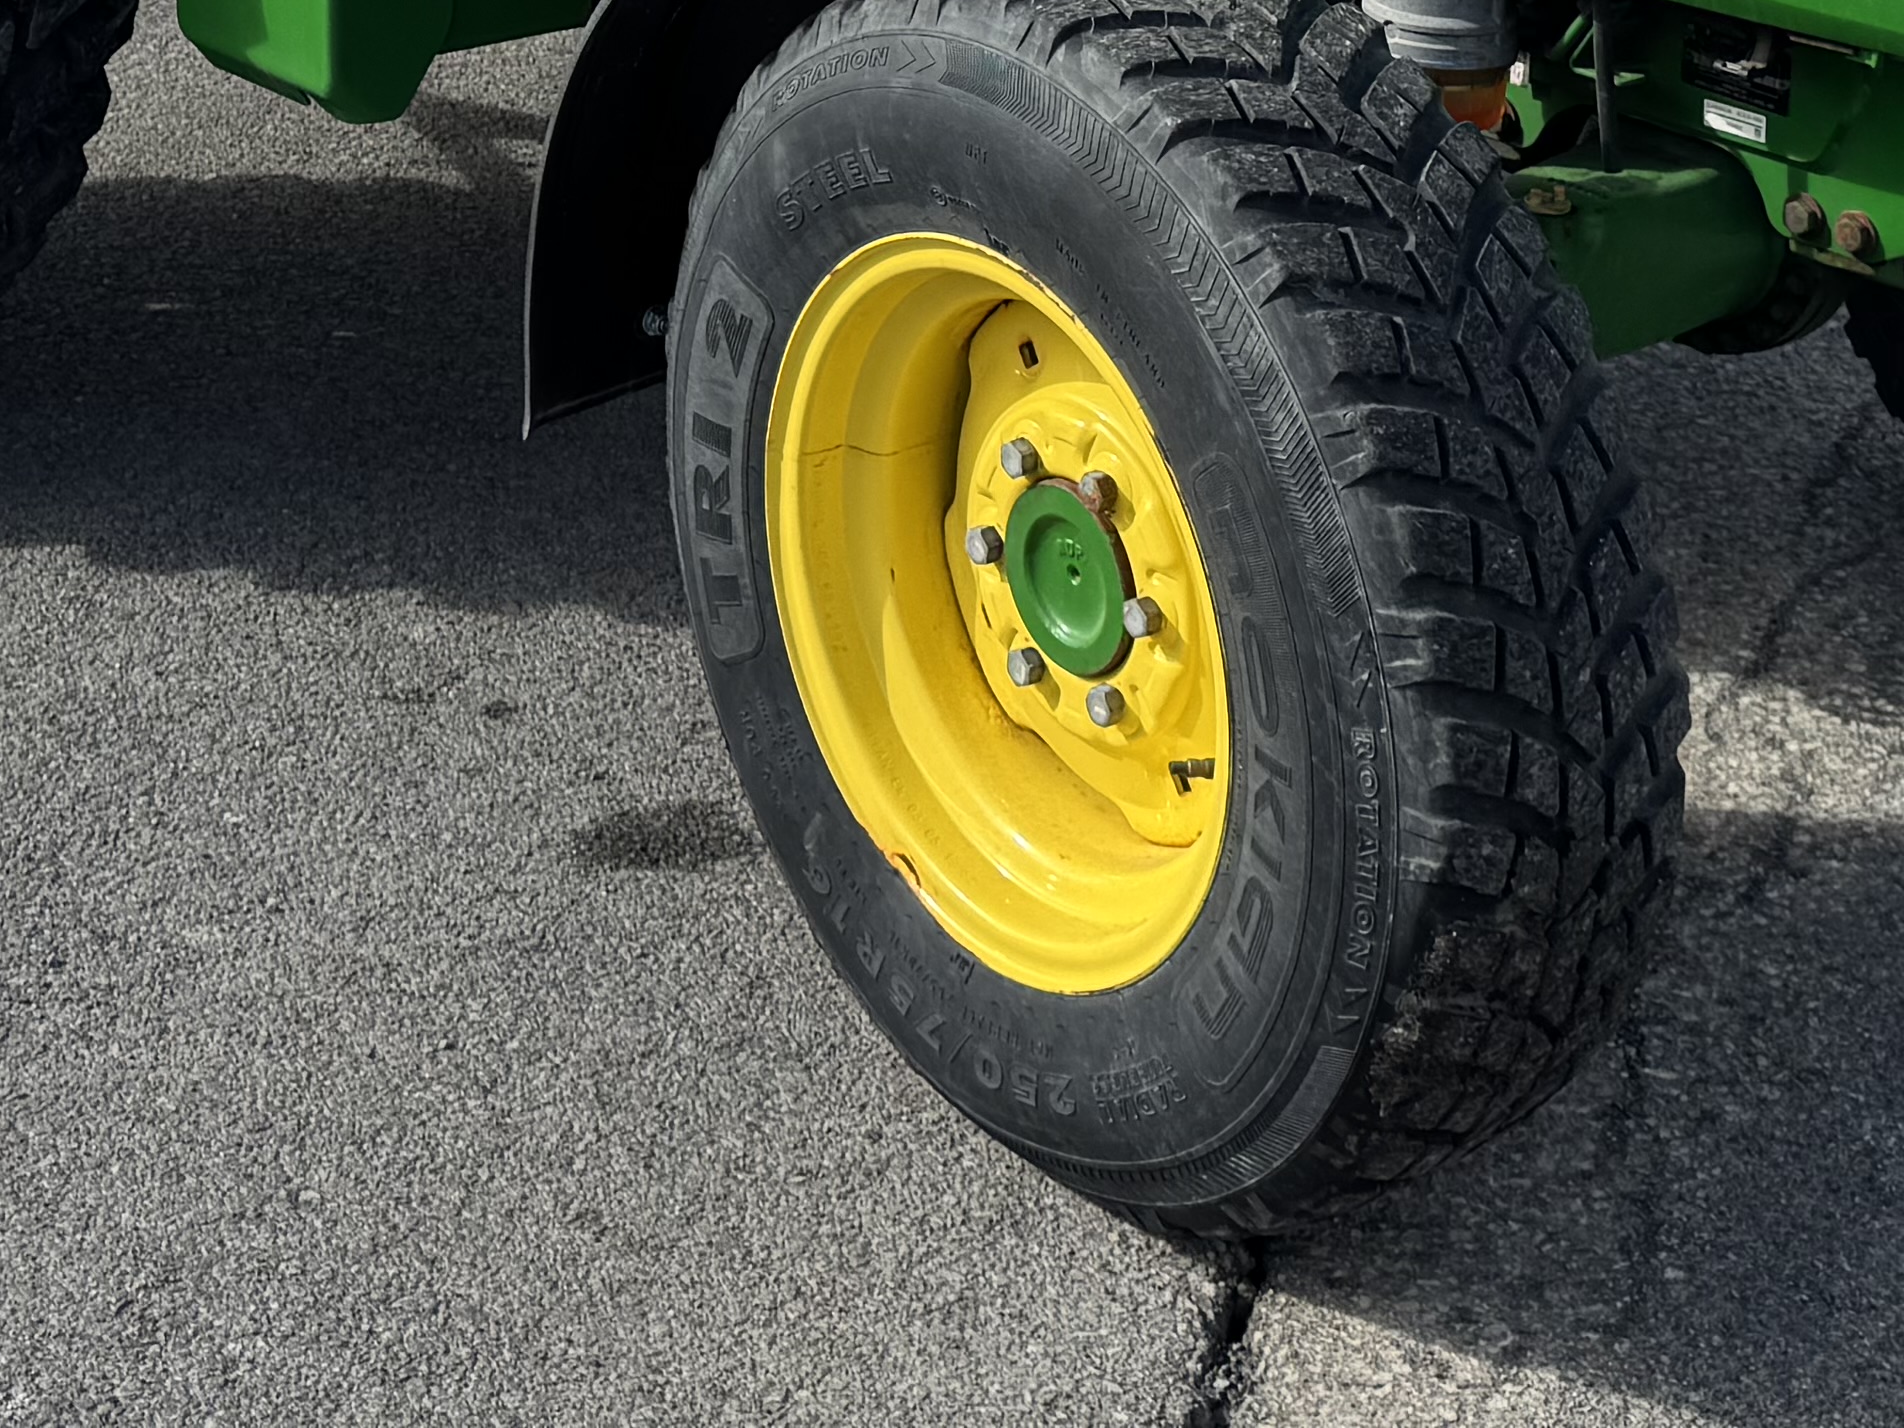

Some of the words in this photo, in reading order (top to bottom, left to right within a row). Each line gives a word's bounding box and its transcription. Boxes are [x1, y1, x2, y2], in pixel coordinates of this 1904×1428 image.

[770, 46, 892, 113] ROTATION
[774, 146, 895, 233] STEEL
[704, 296, 754, 380] 2
[691, 410, 744, 626] TRI
[1343, 727, 1381, 971] ROTATION
